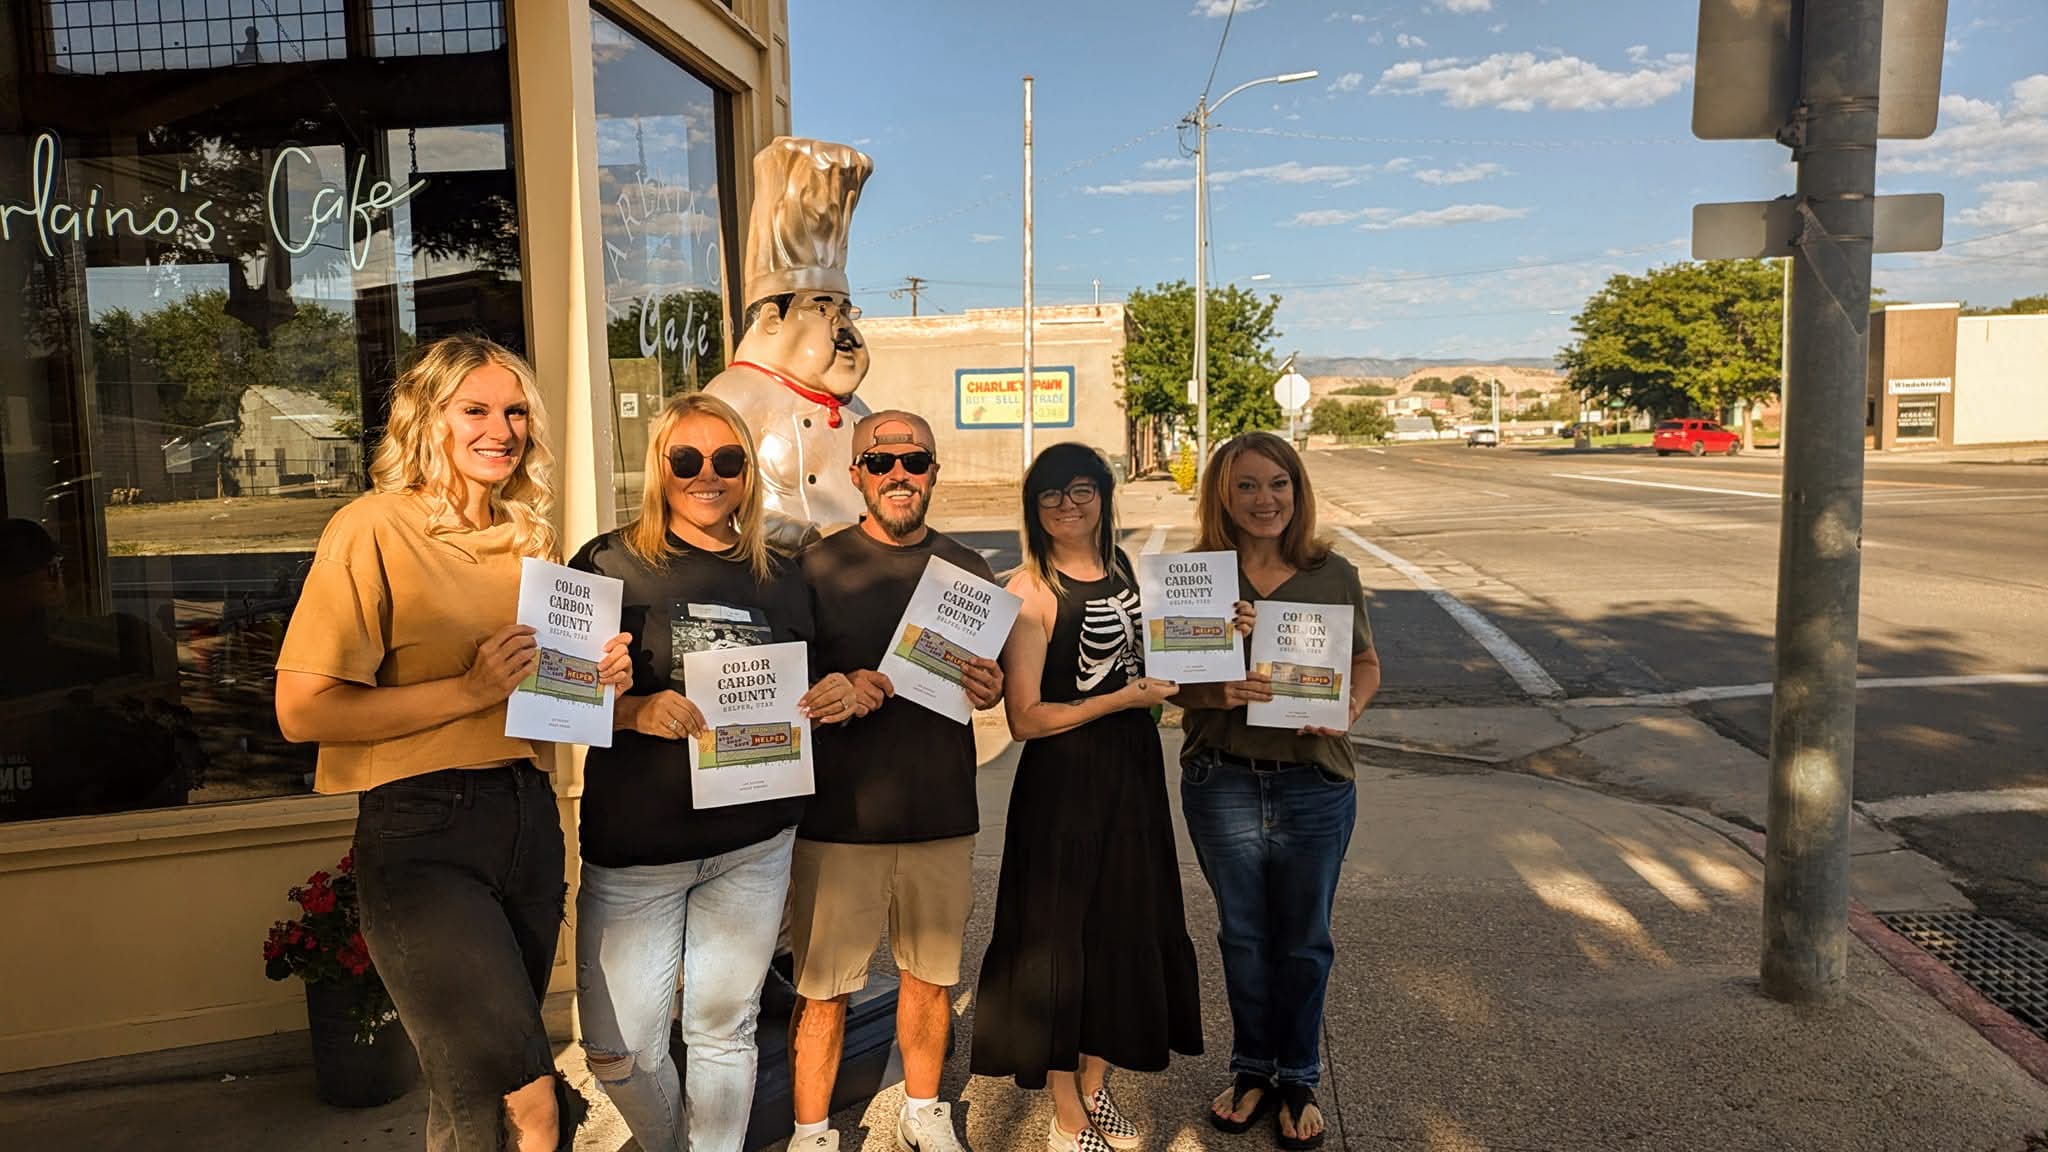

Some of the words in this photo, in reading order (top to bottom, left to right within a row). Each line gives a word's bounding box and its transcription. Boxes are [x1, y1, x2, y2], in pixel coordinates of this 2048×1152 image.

[269, 146, 427, 271] Cafe
[967, 380, 1025, 393] CHARLIE'S
[1032, 378, 1062, 391] PAWN
[995, 395, 1021, 405] SELL
[1034, 394, 1064, 404] TRADE
[1169, 563, 1207, 574] COLOR
[555, 578, 591, 599] COLOR
[1165, 575, 1213, 586] CARBON
[953, 580, 992, 605] COLOR
[1166, 587, 1213, 599] COUNTY
[549, 595, 594, 617] CARBON
[943, 590, 991, 620] CARBON
[548, 612, 593, 633] COUNTY
[937, 603, 986, 632] COUNTY
[1282, 612, 1322, 623] COLOR
[1277, 623, 1326, 636] CARON
[722, 658, 770, 675] COLOR
[567, 670, 593, 682] HELPER
[718, 672, 777, 690] CARBON
[719, 687, 777, 705] COUNTY
[723, 704, 753, 712] HELPER,
[754, 735, 785, 744] HELPER
